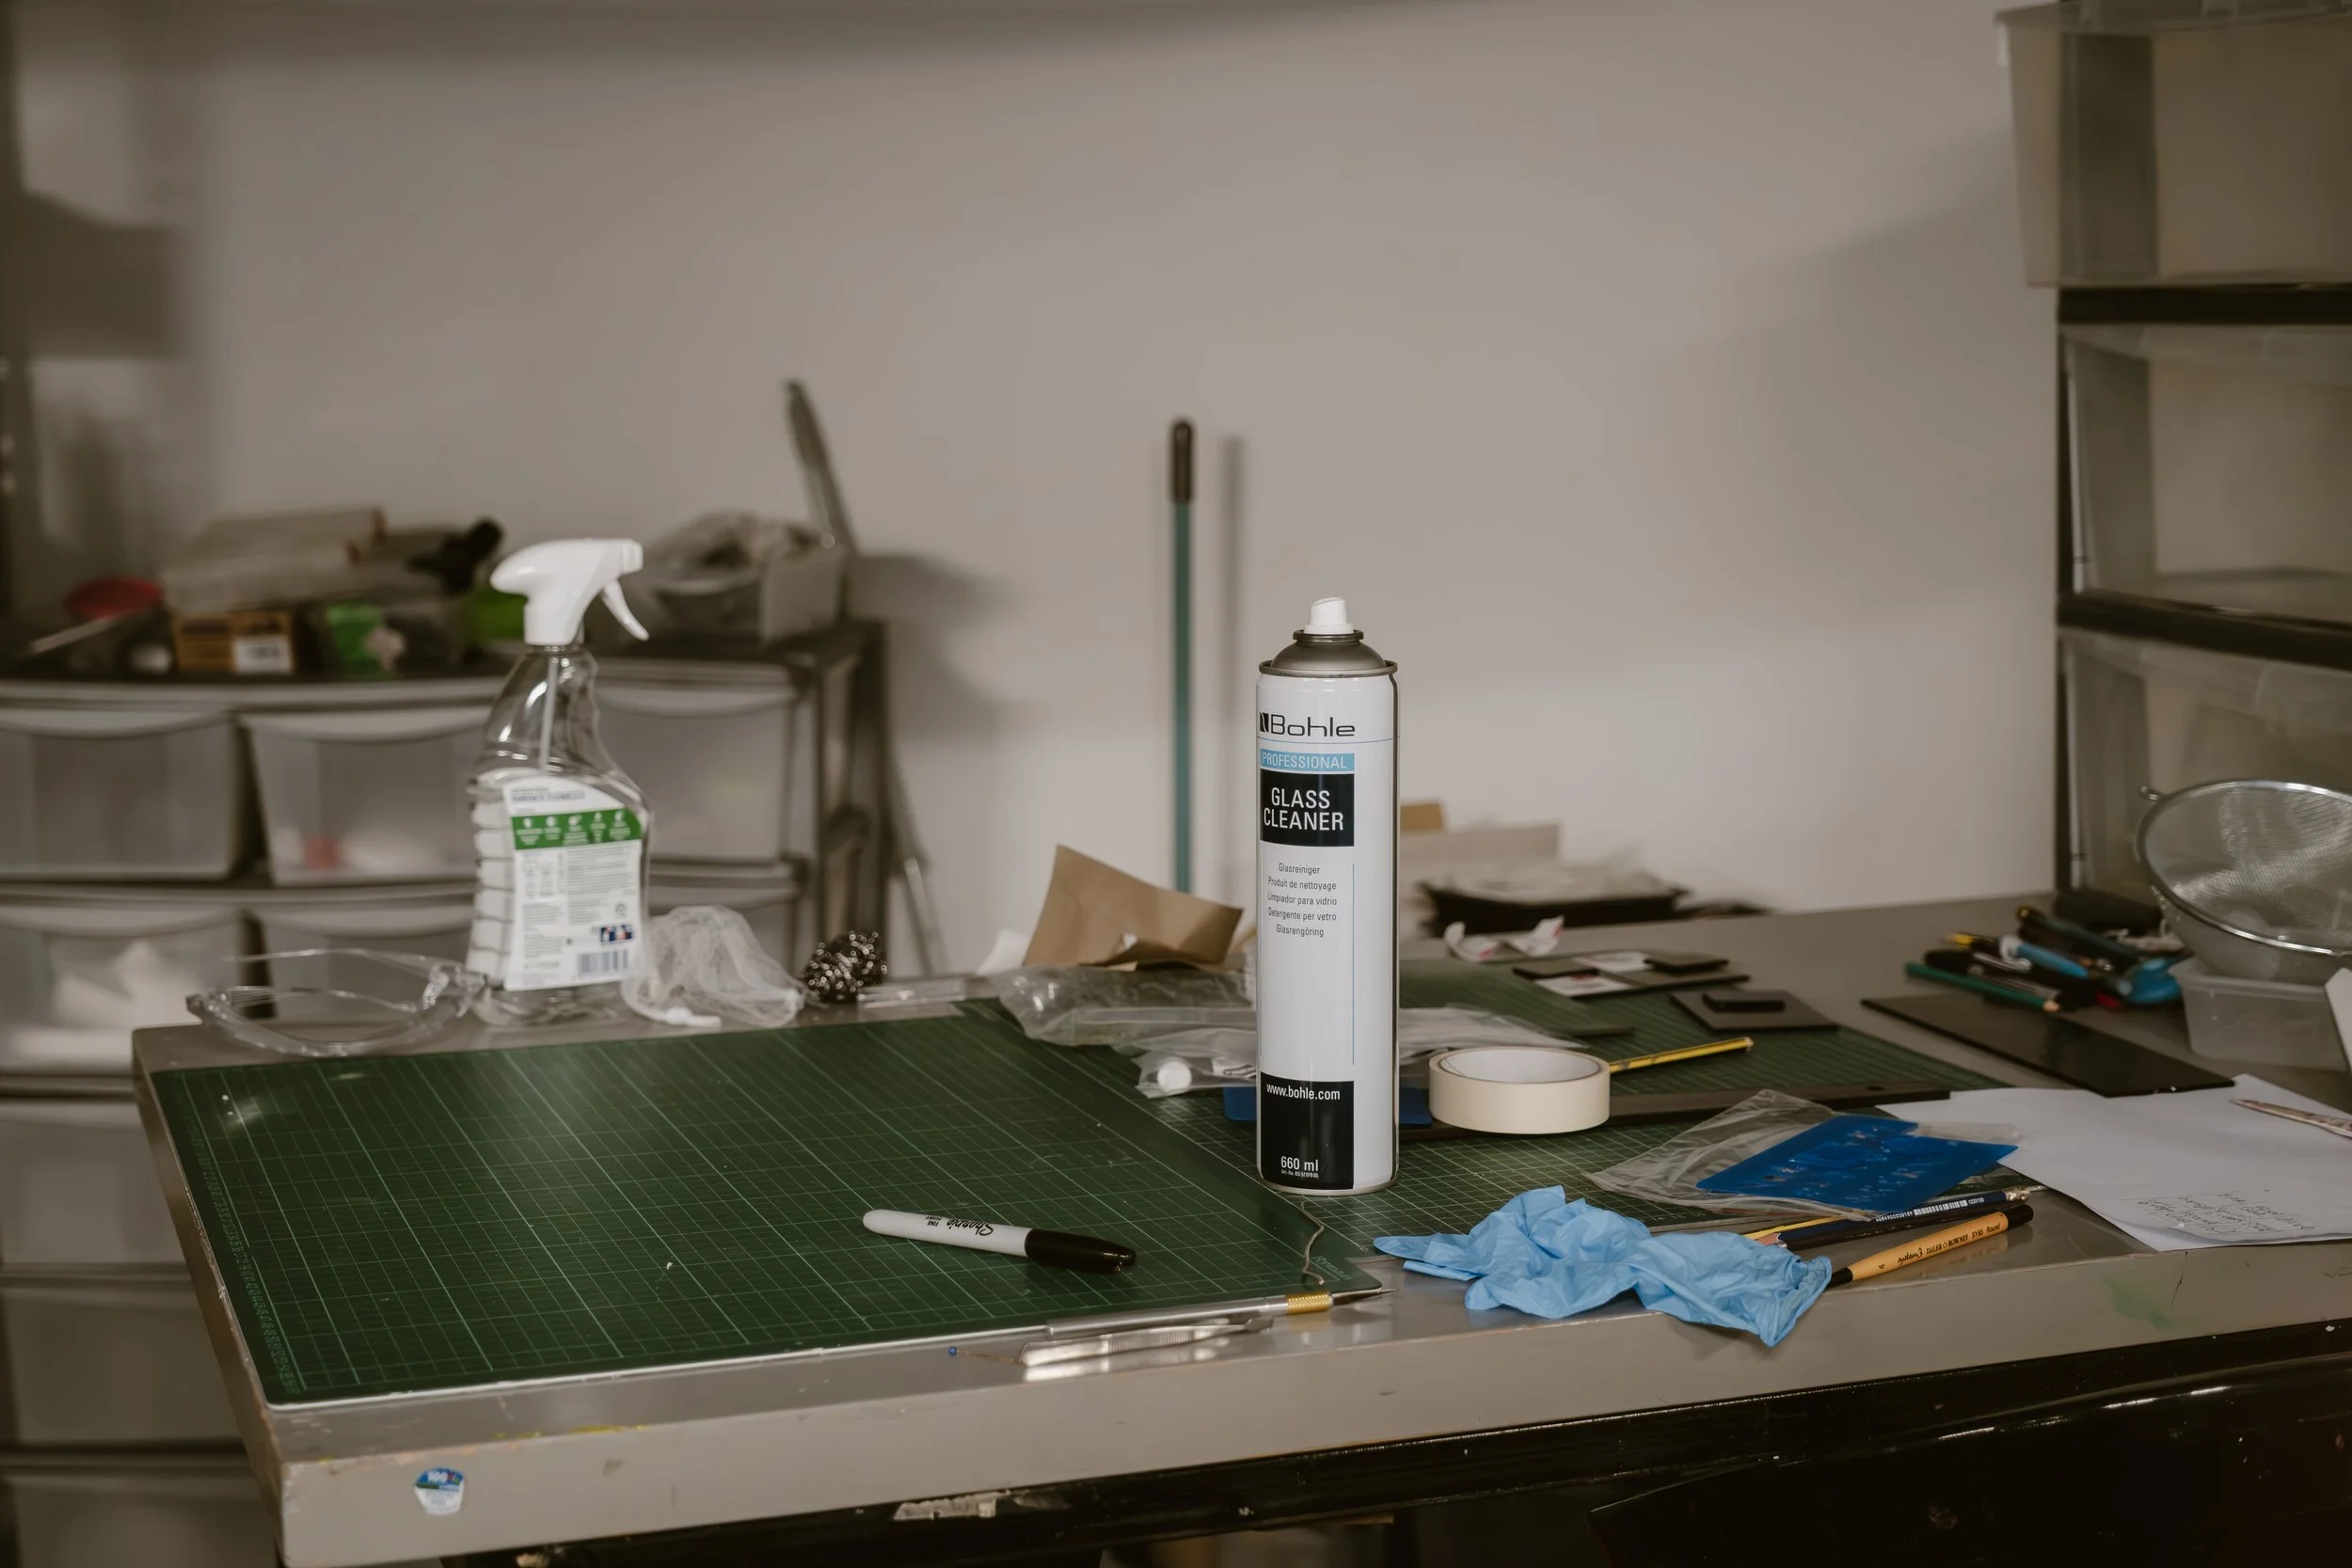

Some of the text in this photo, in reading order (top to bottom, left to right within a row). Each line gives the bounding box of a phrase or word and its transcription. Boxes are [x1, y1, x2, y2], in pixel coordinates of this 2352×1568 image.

[1270, 714, 1356, 737] Bohle
[1263, 752, 1347, 769] PROFESSIONAL
[1271, 787, 1330, 809] GLASS
[1263, 807, 1343, 831] CLEANER
[1279, 862, 1321, 876] Glasreiniger
[1267, 876, 1337, 892] Produit de nettoyage
[1267, 892, 1337, 906] Limpiador para vidrio
[1267, 907, 1337, 922] Detergente per vetro
[1276, 924, 1325, 938] Glasrengöring
[1266, 1084, 1341, 1101] www.bohle.com
[1280, 1155, 1319, 1172] 660 ml
[946, 1218, 993, 1236] Sharpie
